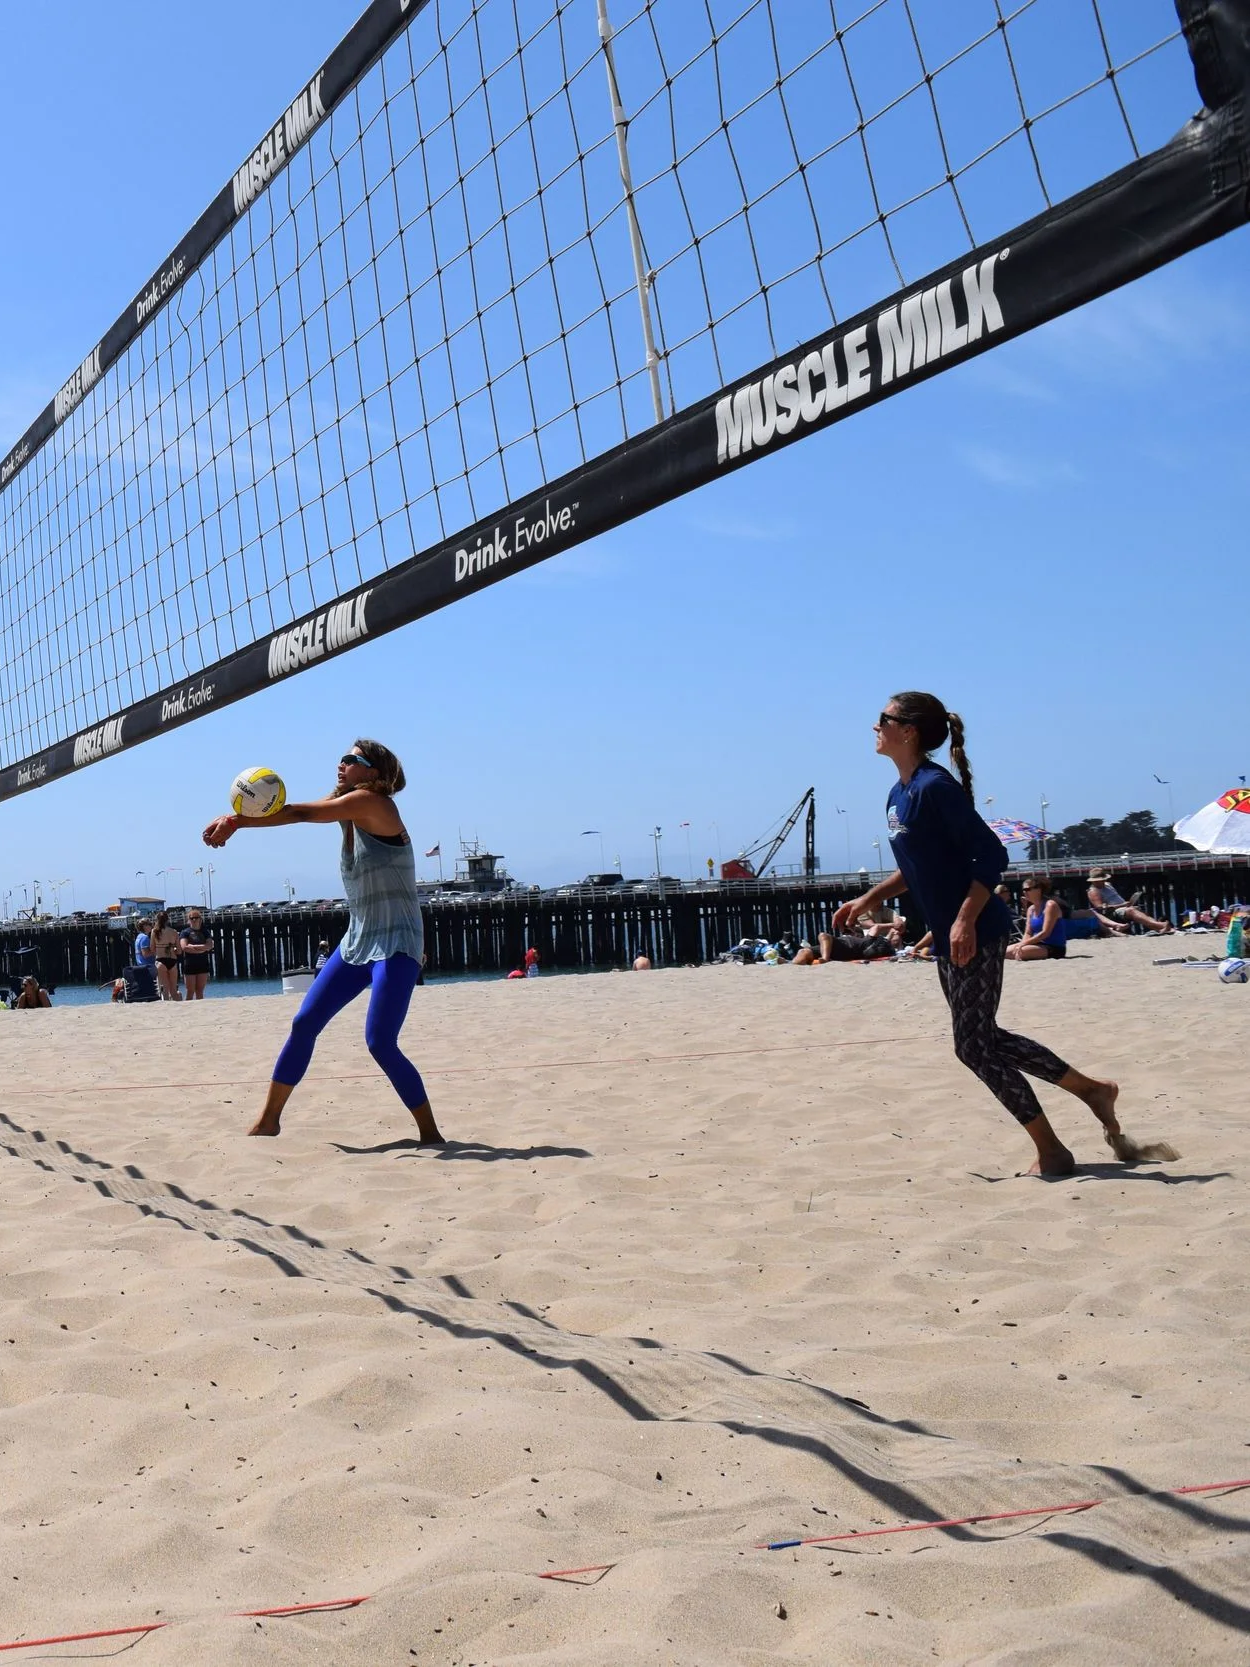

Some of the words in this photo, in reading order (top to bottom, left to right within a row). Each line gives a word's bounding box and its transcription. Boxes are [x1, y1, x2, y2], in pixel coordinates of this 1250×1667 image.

[232, 121, 287, 215] MUSCLE
[284, 71, 326, 153] MILK
[716, 323, 871, 464] MUSCLE
[454, 527, 512, 582] Drink.
[267, 612, 326, 679] MUSCLE
[325, 590, 372, 651] MILK
[161, 694, 187, 722] Drink.
[73, 725, 104, 767] MUSCLE
